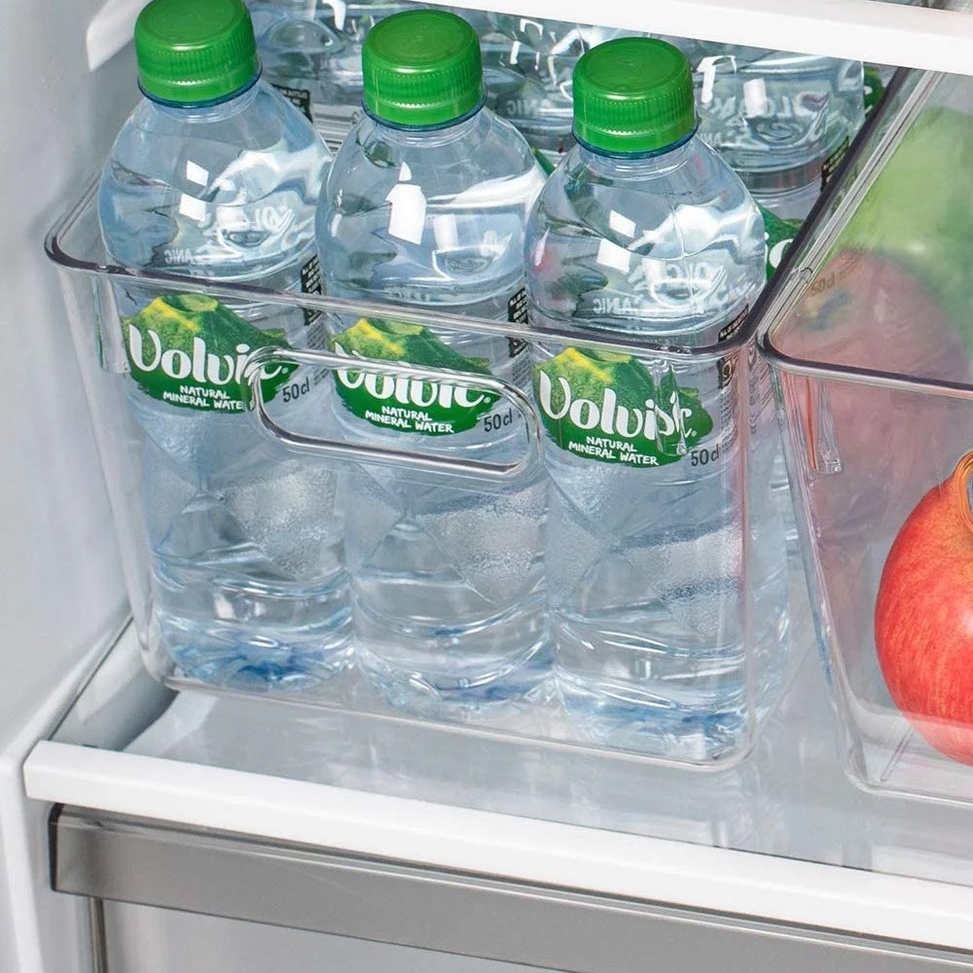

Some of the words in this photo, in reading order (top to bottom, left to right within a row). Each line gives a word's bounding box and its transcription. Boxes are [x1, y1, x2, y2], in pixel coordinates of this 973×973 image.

[162, 391, 210, 408] MINERAL
[213, 399, 247, 411] WATE
[179, 384, 231, 400] NATURAL
[364, 409, 412, 429] MINERAL
[414, 420, 455, 435] WATER
[381, 405, 433, 422] NATURAL
[585, 435, 638, 453] NATURAL
[568, 441, 617, 460] MINERAL
[619, 452, 660, 467] WATER
